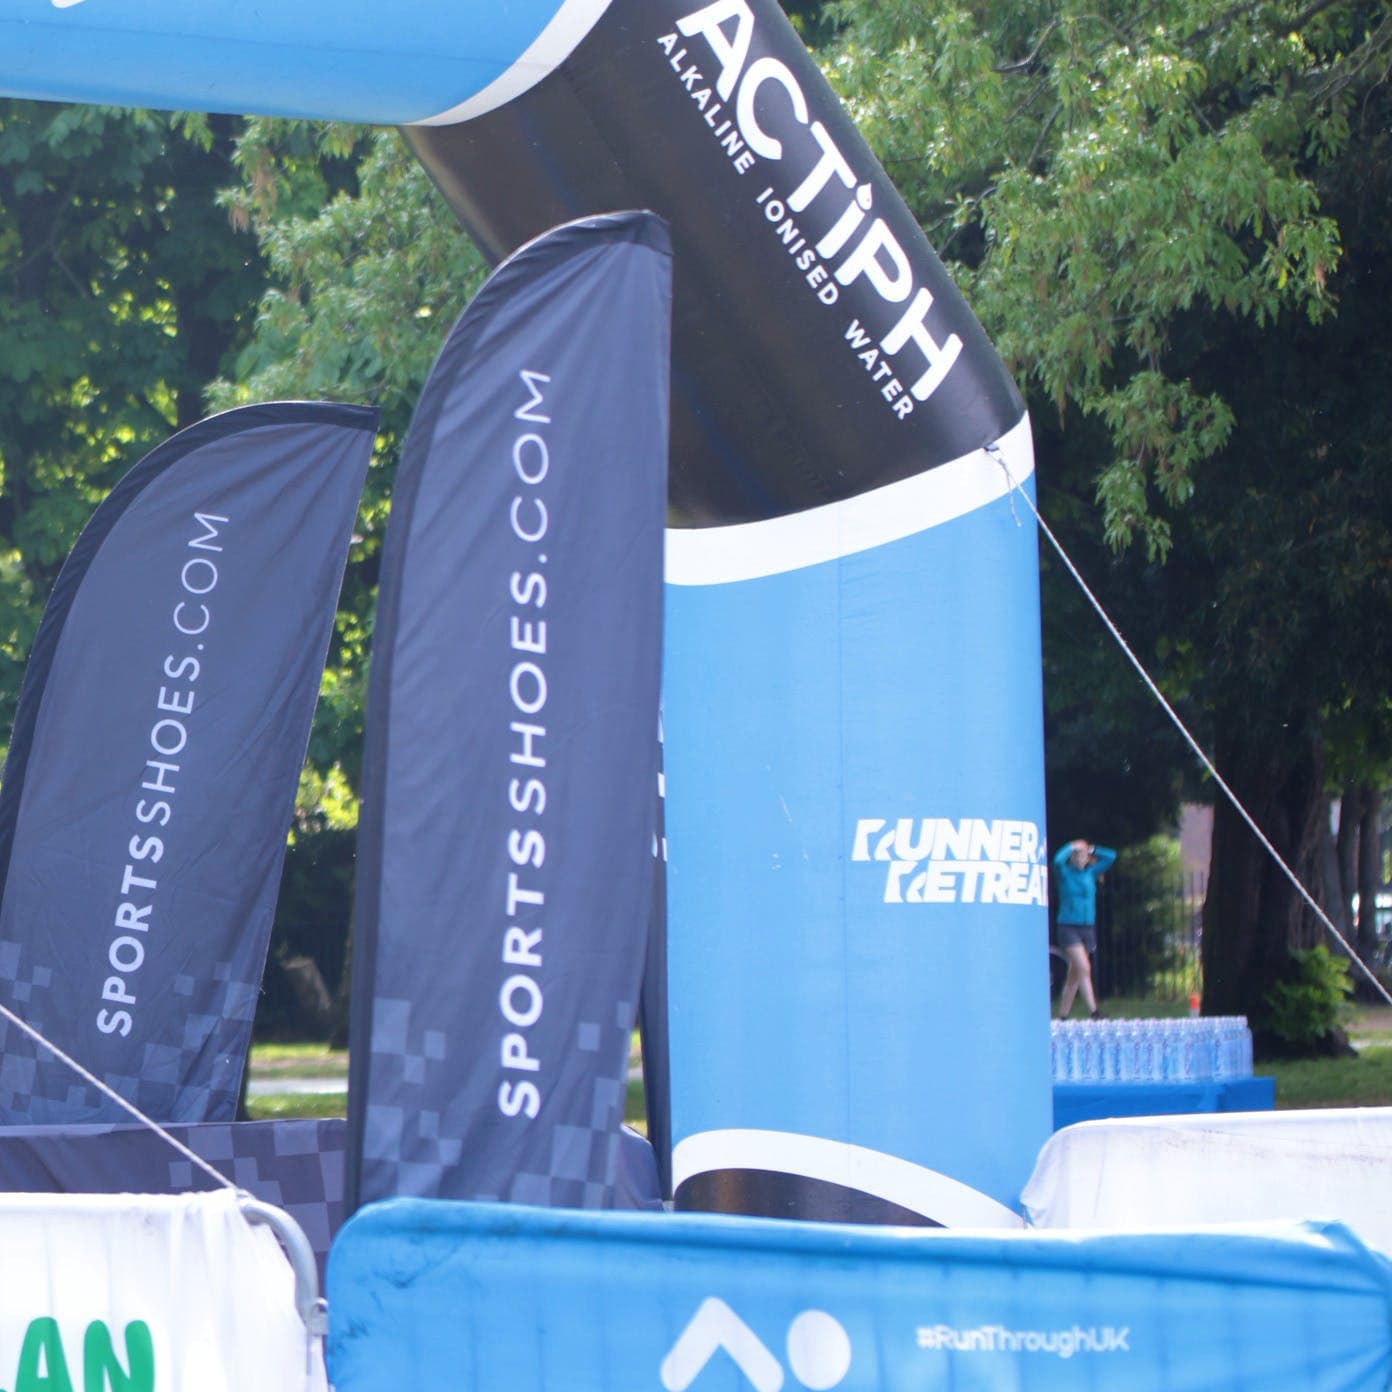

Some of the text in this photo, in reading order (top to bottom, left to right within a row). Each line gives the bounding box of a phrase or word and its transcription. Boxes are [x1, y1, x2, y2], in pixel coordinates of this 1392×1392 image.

[657, 33, 912, 420] ALKALINE IONISED WATER
[97, 511, 228, 1038] SPORTSSHOES.COM
[499, 369, 551, 1118] SPORTSSHOES.COM
[852, 818, 1039, 863] RUNNER
[916, 1325, 1130, 1358] #RunThroughUK
